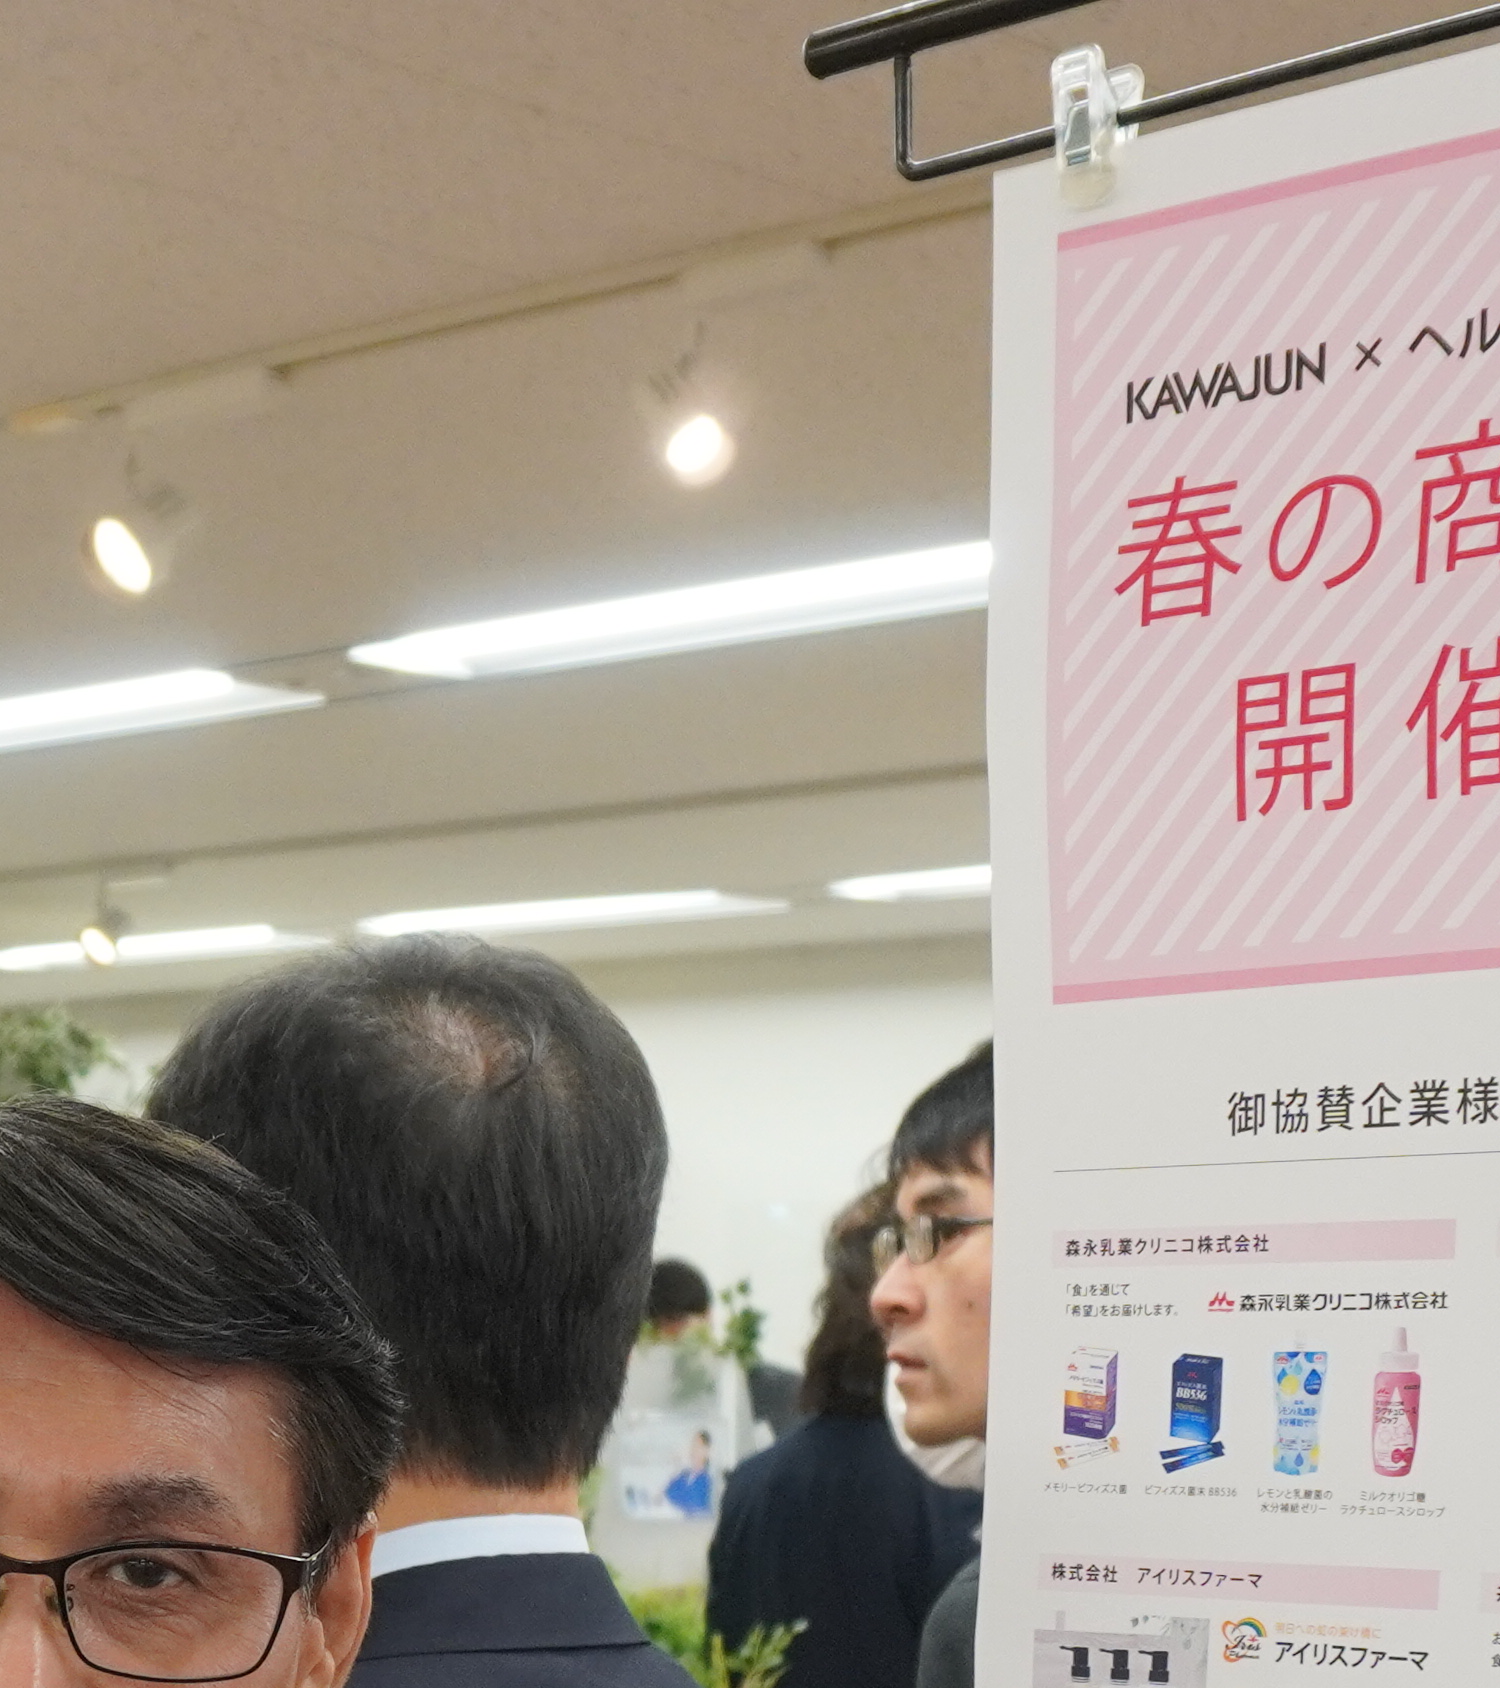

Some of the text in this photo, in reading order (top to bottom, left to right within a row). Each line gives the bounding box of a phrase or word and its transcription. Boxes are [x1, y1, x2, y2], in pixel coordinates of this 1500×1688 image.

[1125, 341, 1327, 424] KAWAJUN
[1227, 1075, 1500, 1137] 御協賛企業様
[1065, 1234, 1270, 1258] 森永乳業クリニコ株式会社
[1065, 1282, 1130, 1297] 「食」を通じて
[1239, 1291, 1449, 1312] 森永乳業クリニコ株式会社
[1051, 1562, 1263, 1588] 株式会社 アイリスファーマ
[1275, 1641, 1430, 1671] アイリスファーマ
